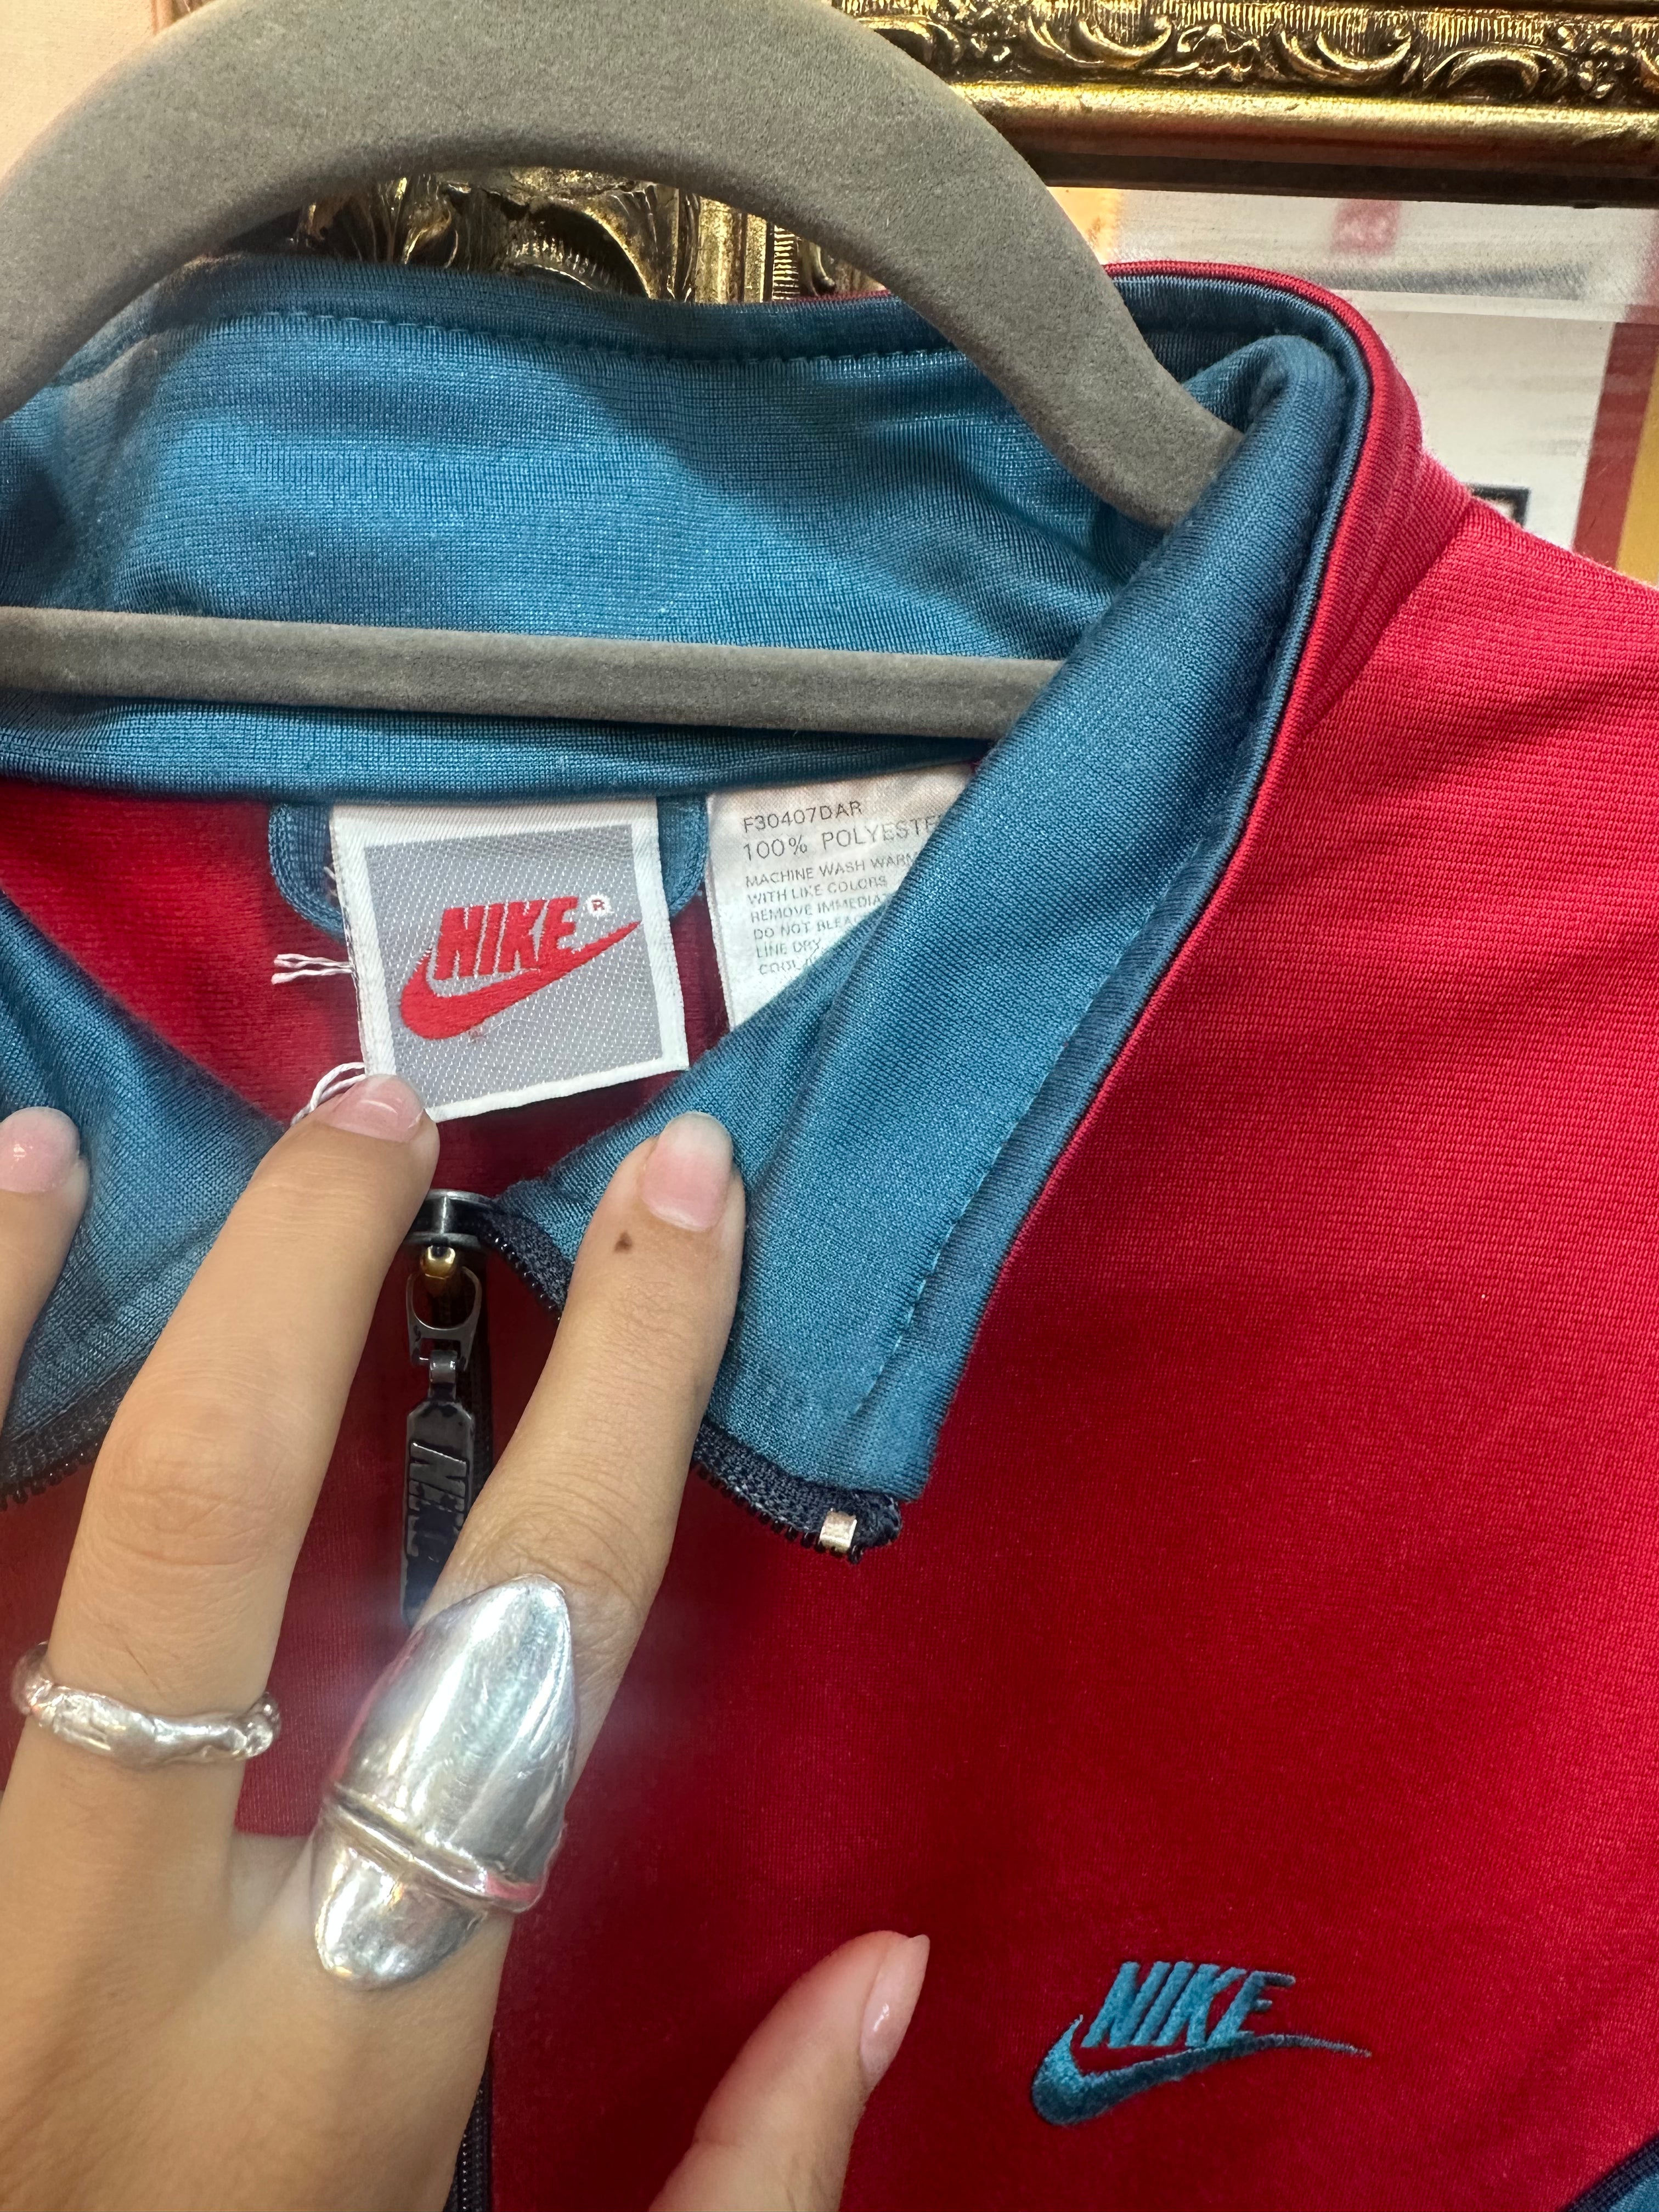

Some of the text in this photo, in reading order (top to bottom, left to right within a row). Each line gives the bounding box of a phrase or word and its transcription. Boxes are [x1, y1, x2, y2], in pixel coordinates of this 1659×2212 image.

[743, 800, 863, 833] F30407DAR
[743, 814, 941, 861] 100% POLYESTE
[746, 867, 814, 888] MACHINE
[819, 860, 865, 877] WASH
[748, 875, 888, 905] WITH LIKE COLORS
[751, 893, 887, 923] REMOVE IMMEDIA
[434, 895, 580, 981] NIKE
[753, 927, 775, 940] DO
[781, 920, 811, 937] NOT
[755, 938, 821, 958] LINE DRY
[1080, 1960, 1296, 2049] NIKE
